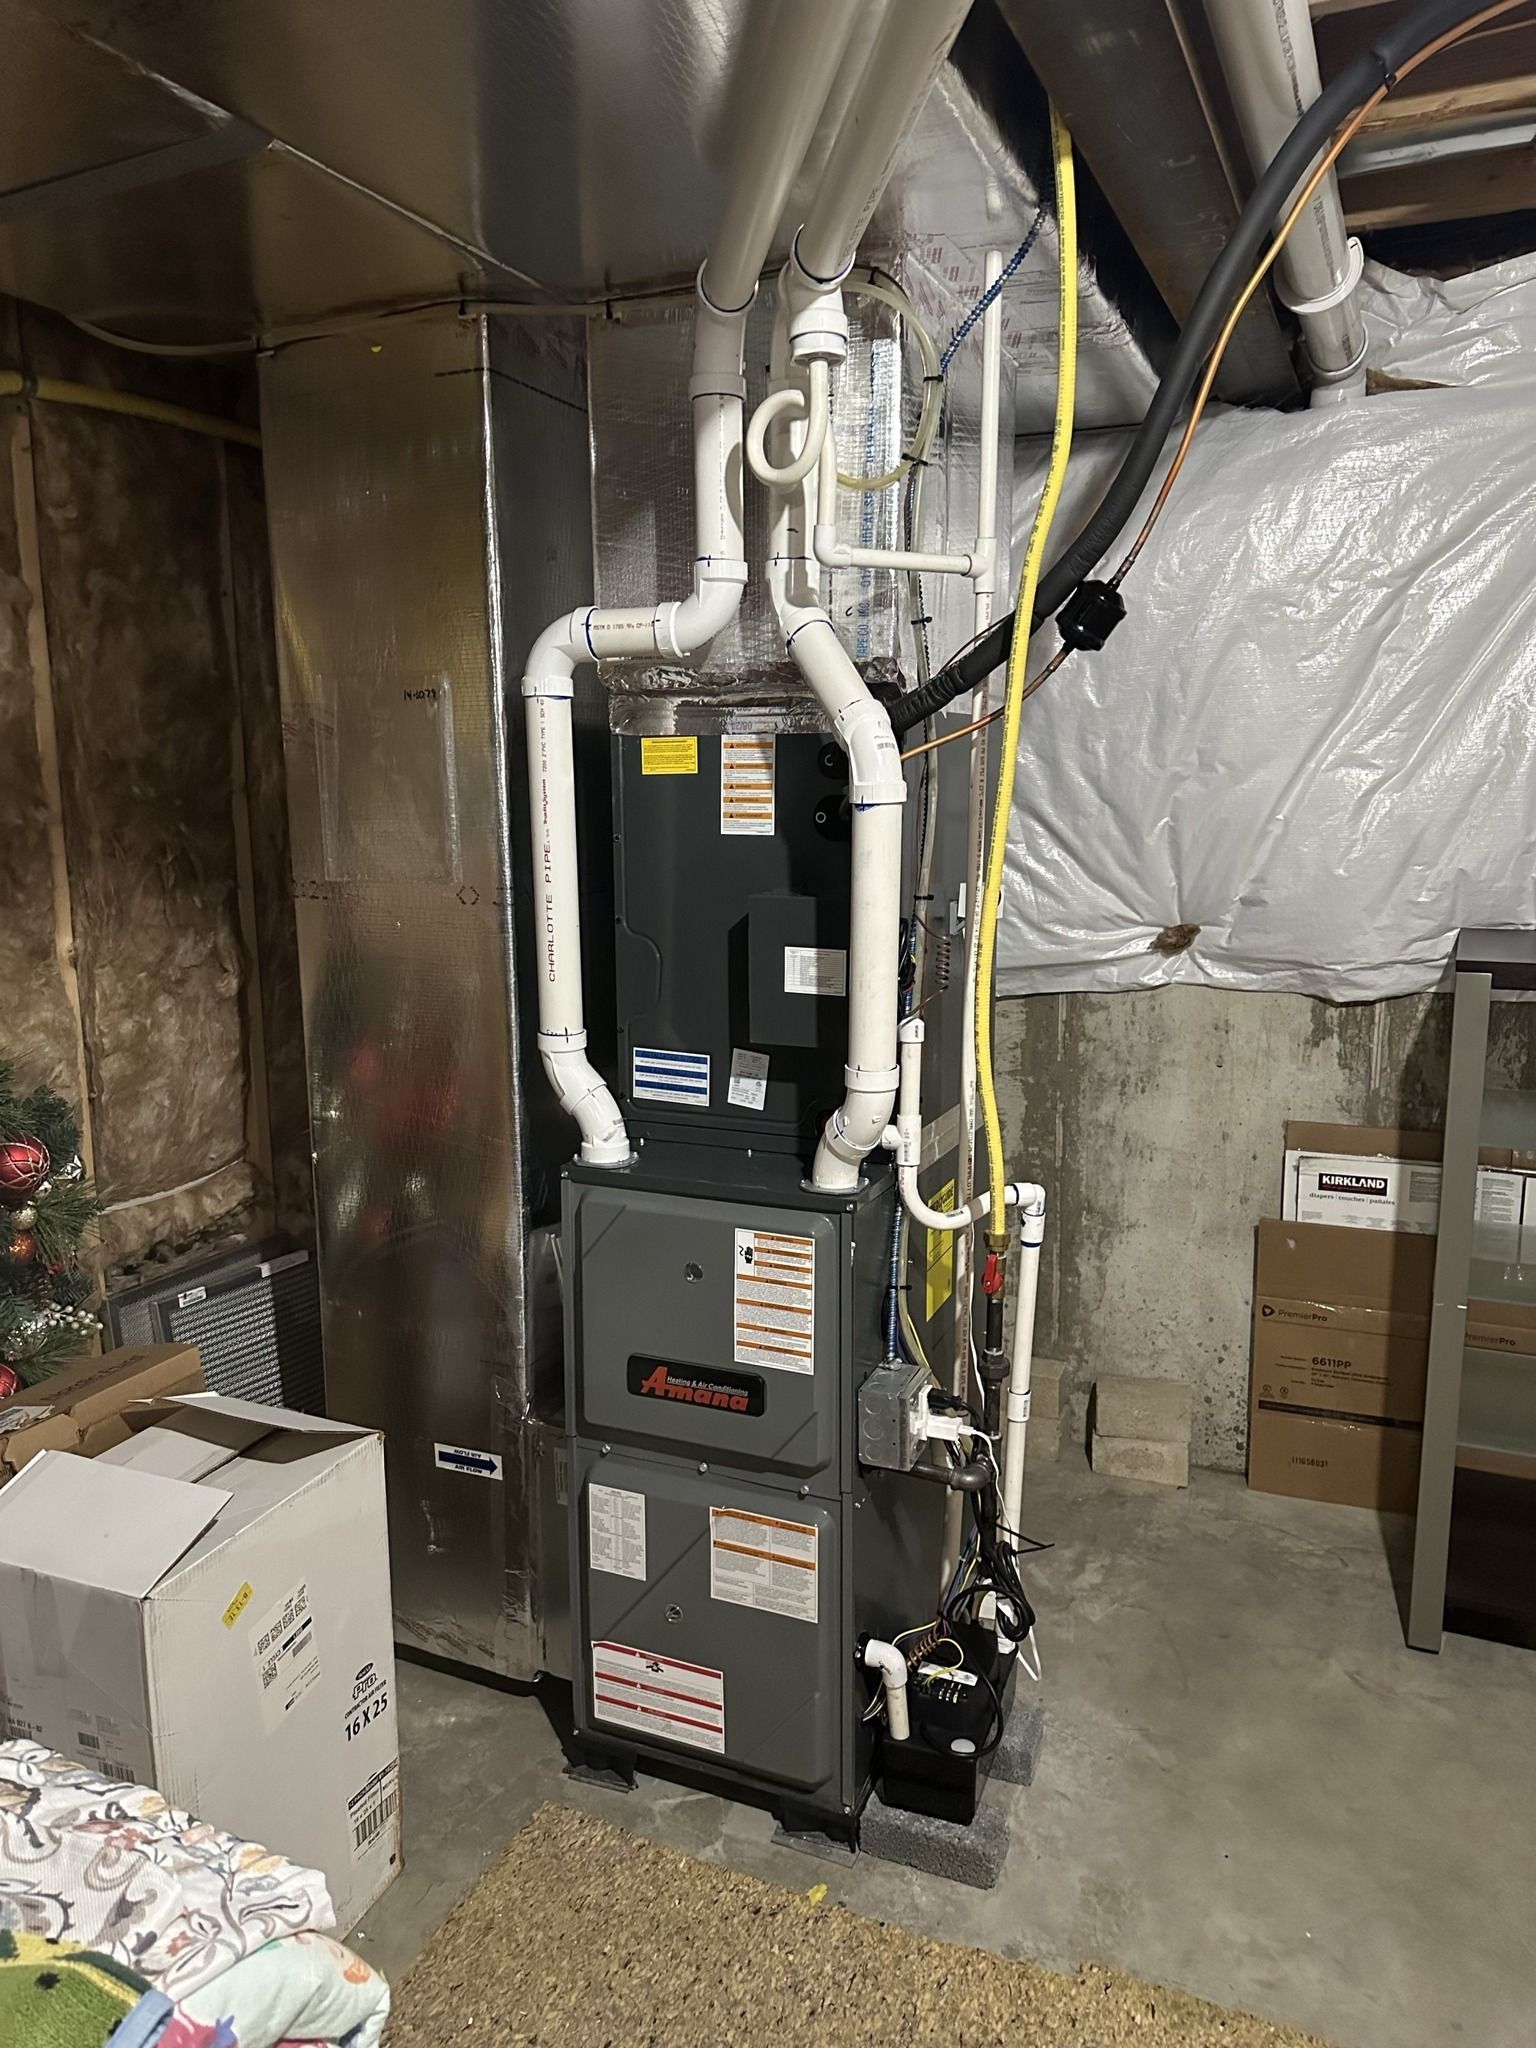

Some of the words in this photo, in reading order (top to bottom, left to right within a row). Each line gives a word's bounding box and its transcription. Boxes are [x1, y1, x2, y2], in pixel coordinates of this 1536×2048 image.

[543, 844, 552, 884] PIPE
[546, 894, 556, 983] CHARLOTTE
[1322, 1175, 1385, 1189] KIRKLAND
[1278, 1309, 1328, 1322] PremierPro
[1312, 1357, 1352, 1369] 6611PP
[641, 1366, 749, 1411] Amana
[667, 1376, 690, 1387] Heating
[691, 1379, 697, 1388] &
[698, 1380, 708, 1390] Air
[709, 1383, 749, 1397] Conditioning
[466, 1466, 483, 1474] FLOW
[352, 1672, 378, 1700] Pro
[345, 1716, 361, 1742] 16
[362, 1706, 371, 1729] X
[373, 1692, 388, 1719] 25
